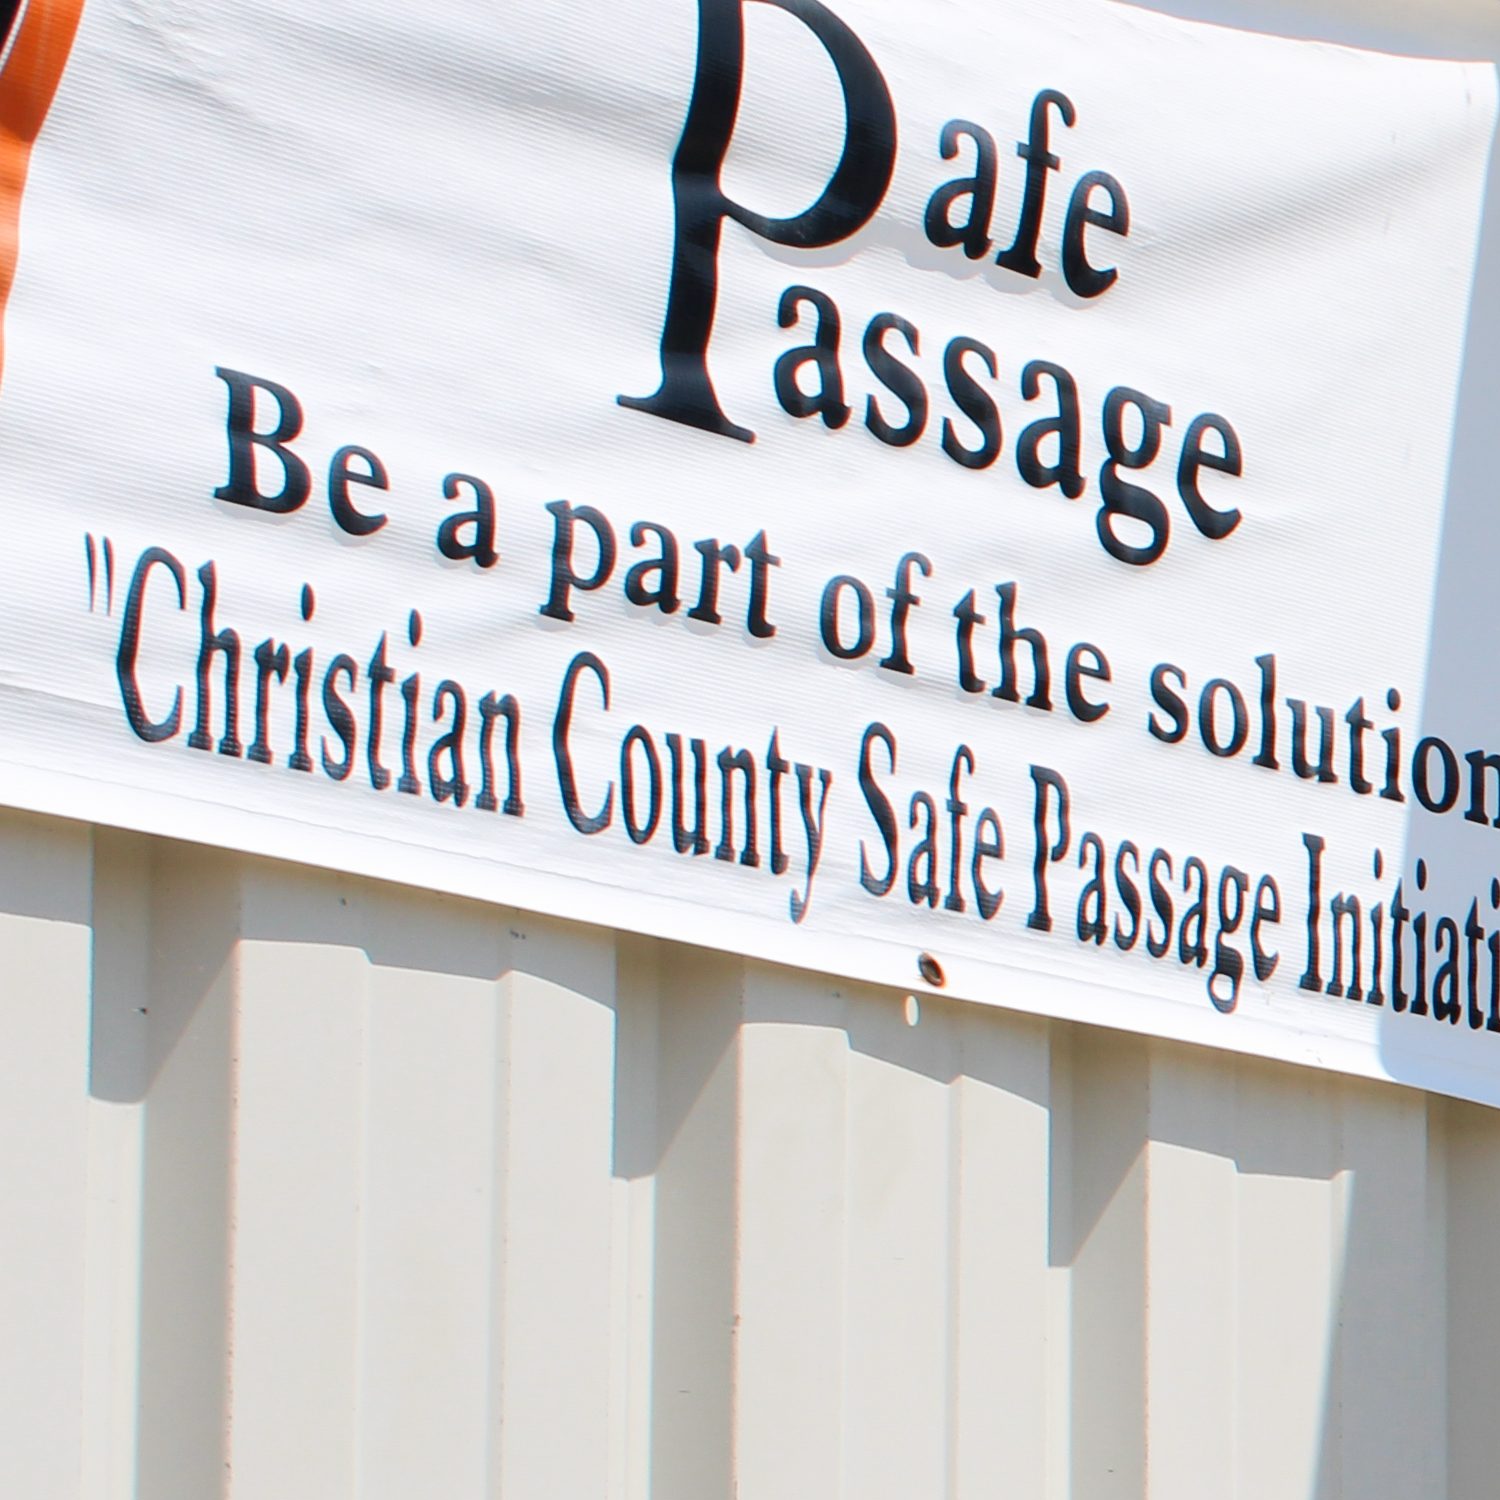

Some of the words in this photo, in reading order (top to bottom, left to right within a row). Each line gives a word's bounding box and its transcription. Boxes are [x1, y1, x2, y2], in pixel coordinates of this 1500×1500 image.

[213, 365, 390, 538] Be
[437, 471, 500, 569] a
[539, 498, 782, 640] part
[819, 551, 933, 677] of
[952, 580, 1112, 723] the
[84, 530, 526, 818] "Christian
[551, 650, 833, 924] County
[857, 721, 1005, 922] Safe
[1026, 763, 1282, 1015] Passage
